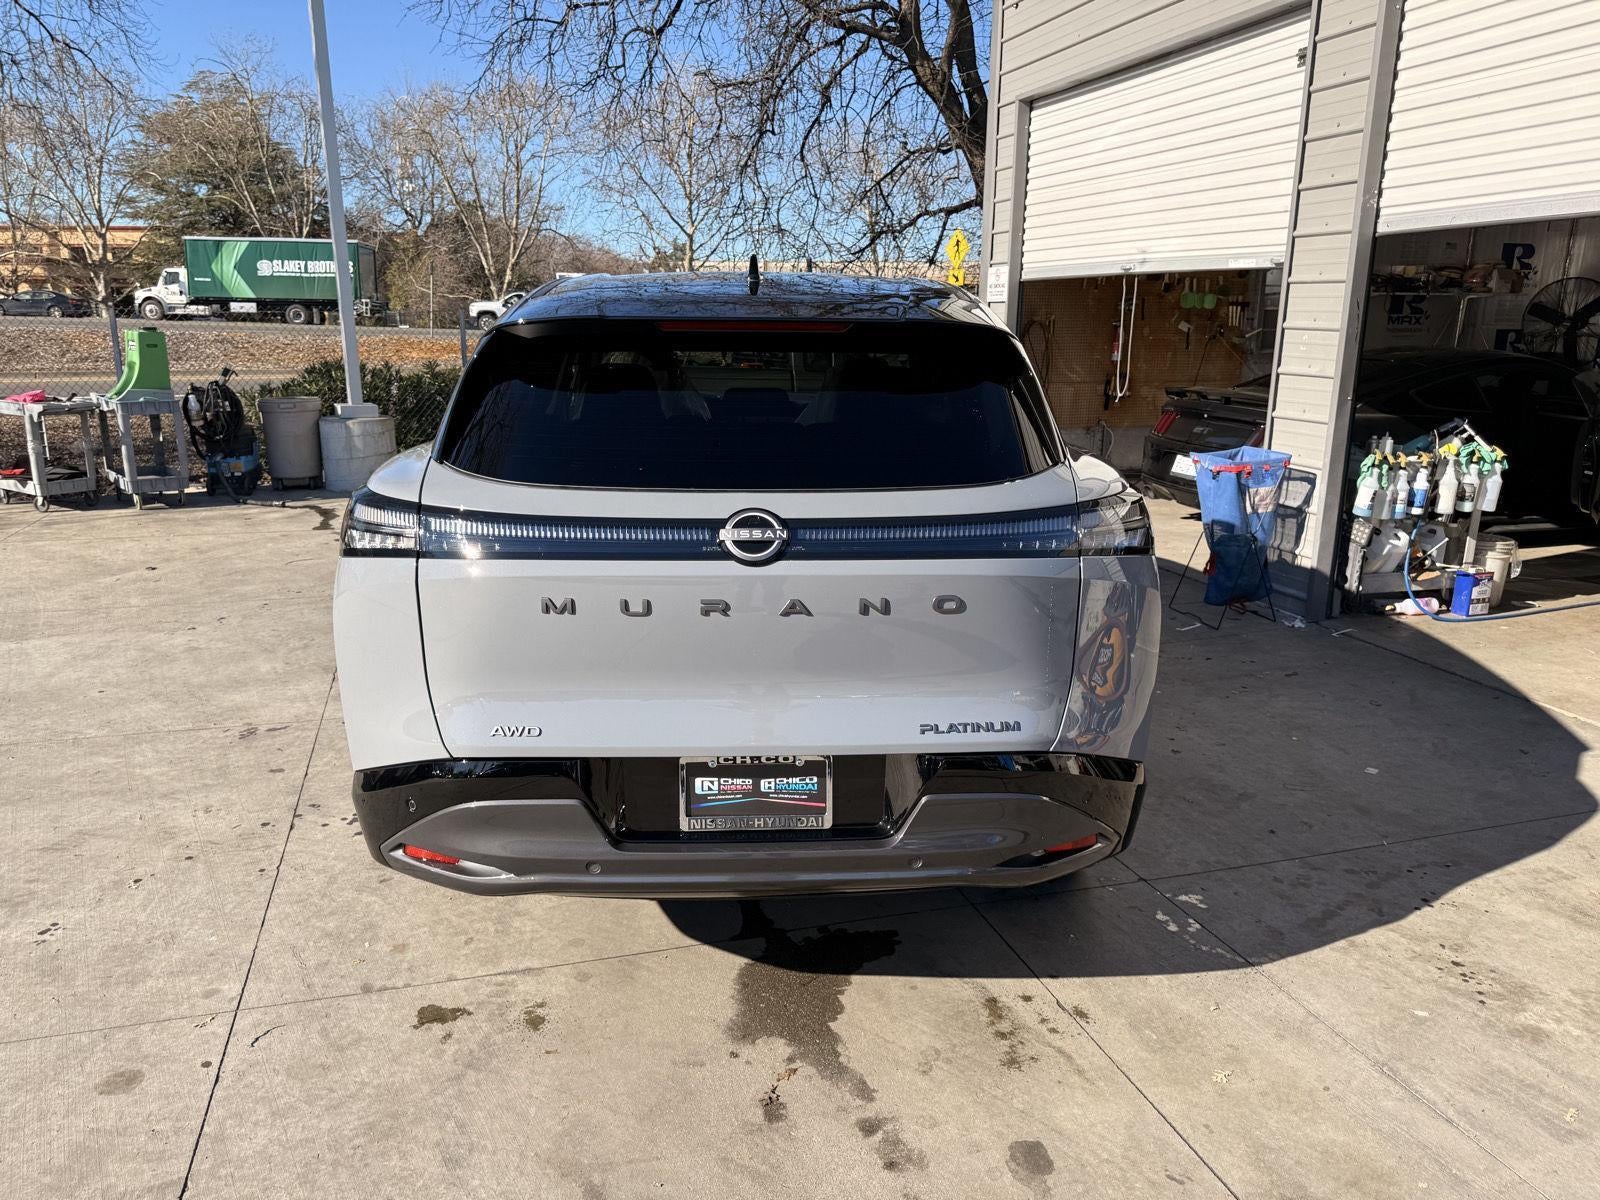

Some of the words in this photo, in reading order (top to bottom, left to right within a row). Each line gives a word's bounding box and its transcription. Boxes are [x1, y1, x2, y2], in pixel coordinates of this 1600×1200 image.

[272, 260, 305, 273] SLAKEY
[307, 260, 354, 273] BROTHS
[721, 530, 787, 539] NISSAN
[540, 594, 968, 618] MURANO
[489, 725, 543, 738] AWD
[919, 721, 1022, 735] PLATINUM
[776, 776, 818, 784] CHICO
[690, 817, 823, 829] NISSAN-HYUNDAI
